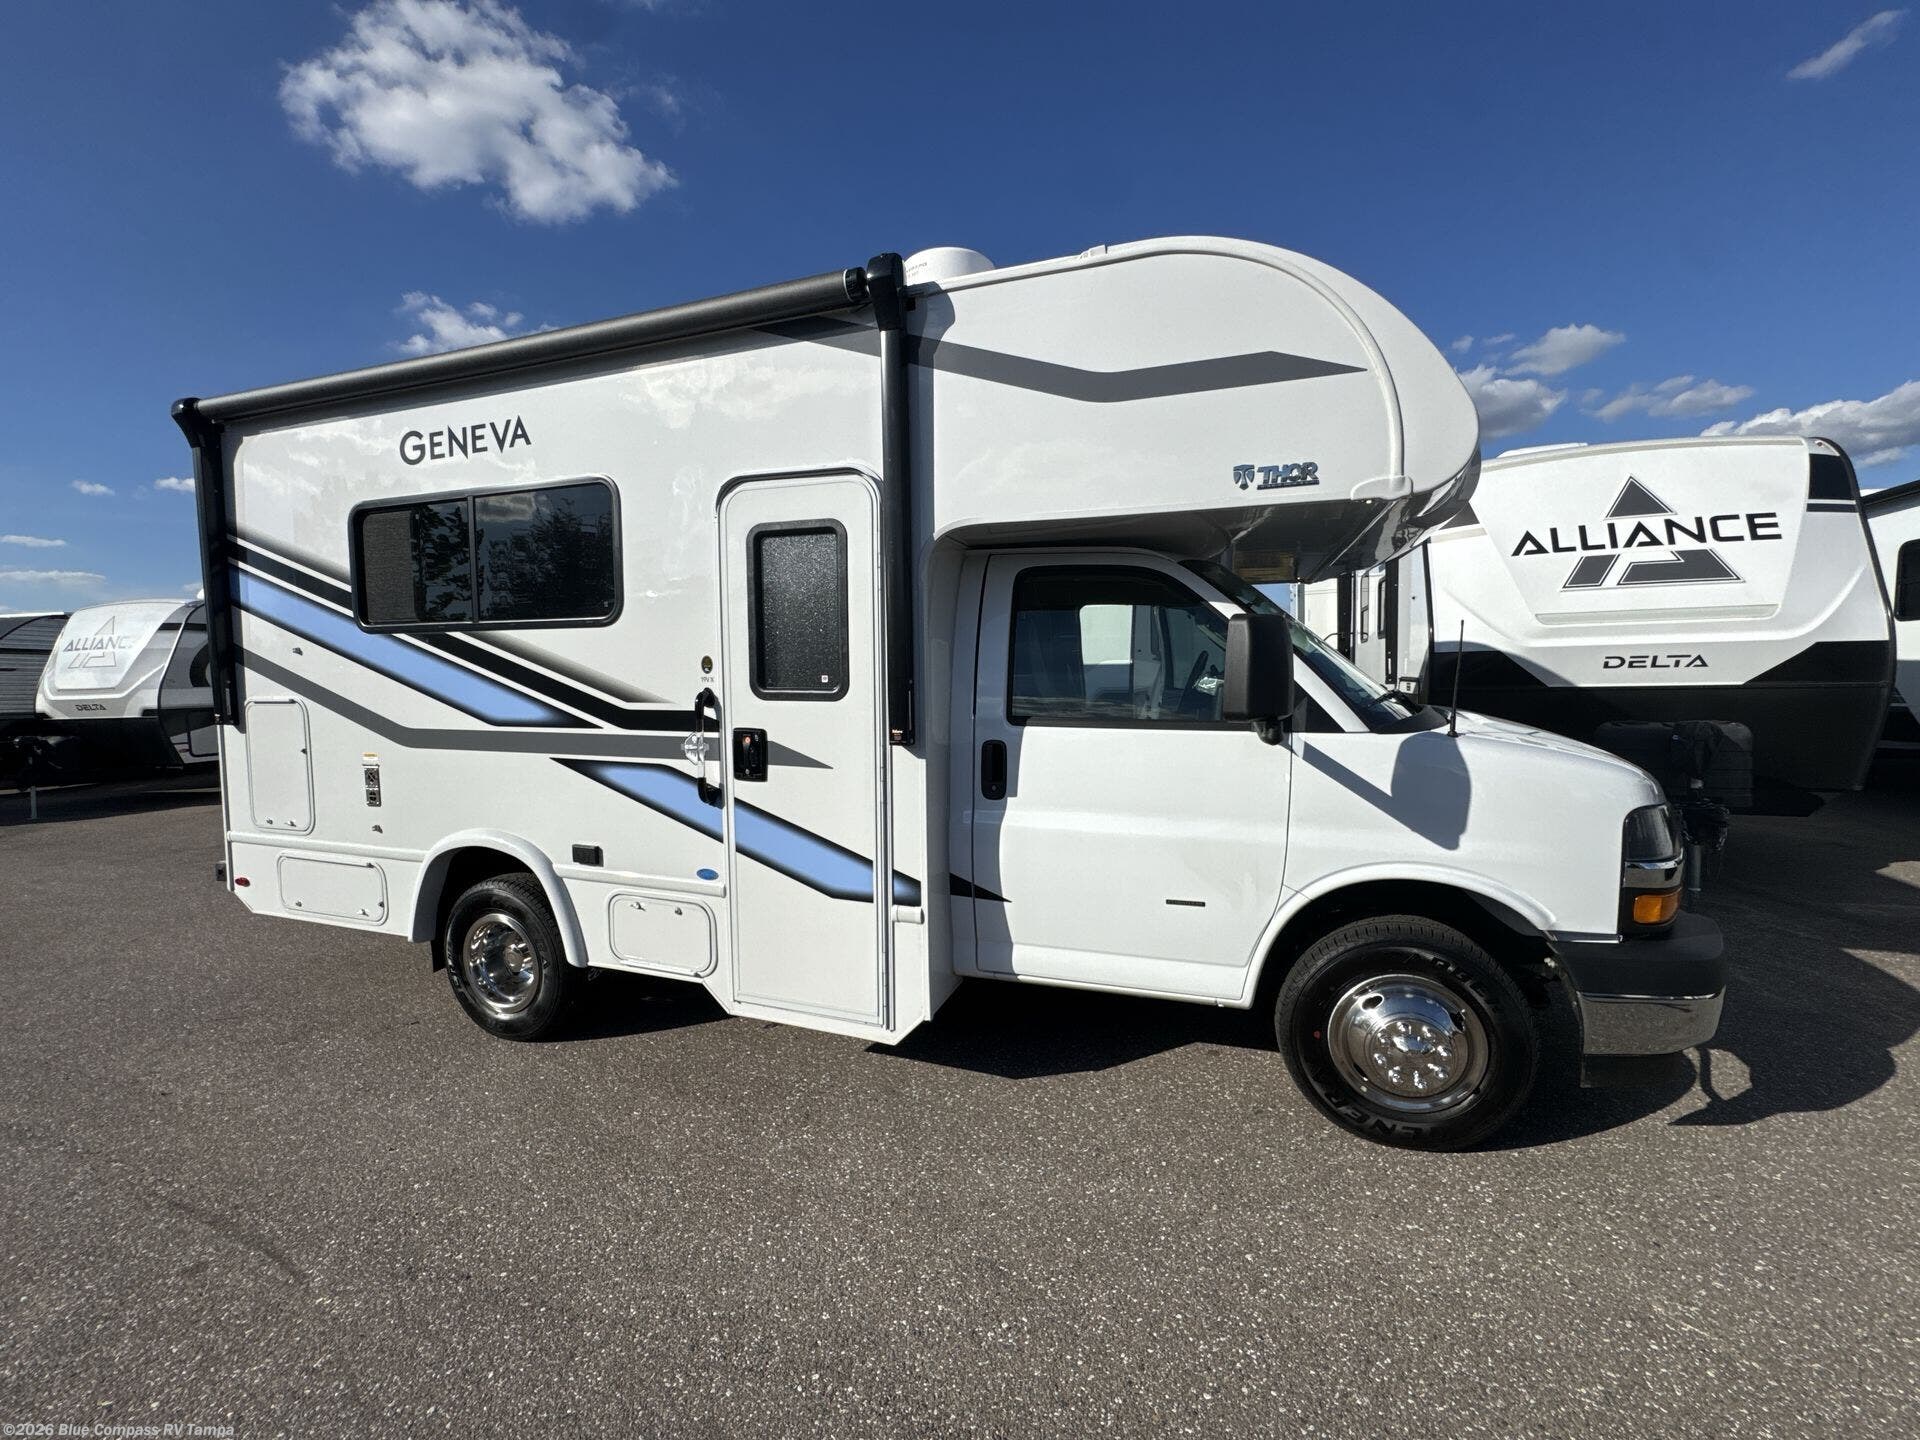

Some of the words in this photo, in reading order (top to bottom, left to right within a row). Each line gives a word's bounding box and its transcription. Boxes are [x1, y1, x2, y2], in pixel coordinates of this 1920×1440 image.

[399, 414, 532, 466] GENEVA
[1257, 461, 1319, 484] THOR
[1511, 512, 1783, 556] ALLIANCE
[63, 636, 133, 653] ALLIANC
[1603, 654, 1709, 669] DELTA
[75, 703, 107, 711] DELTA
